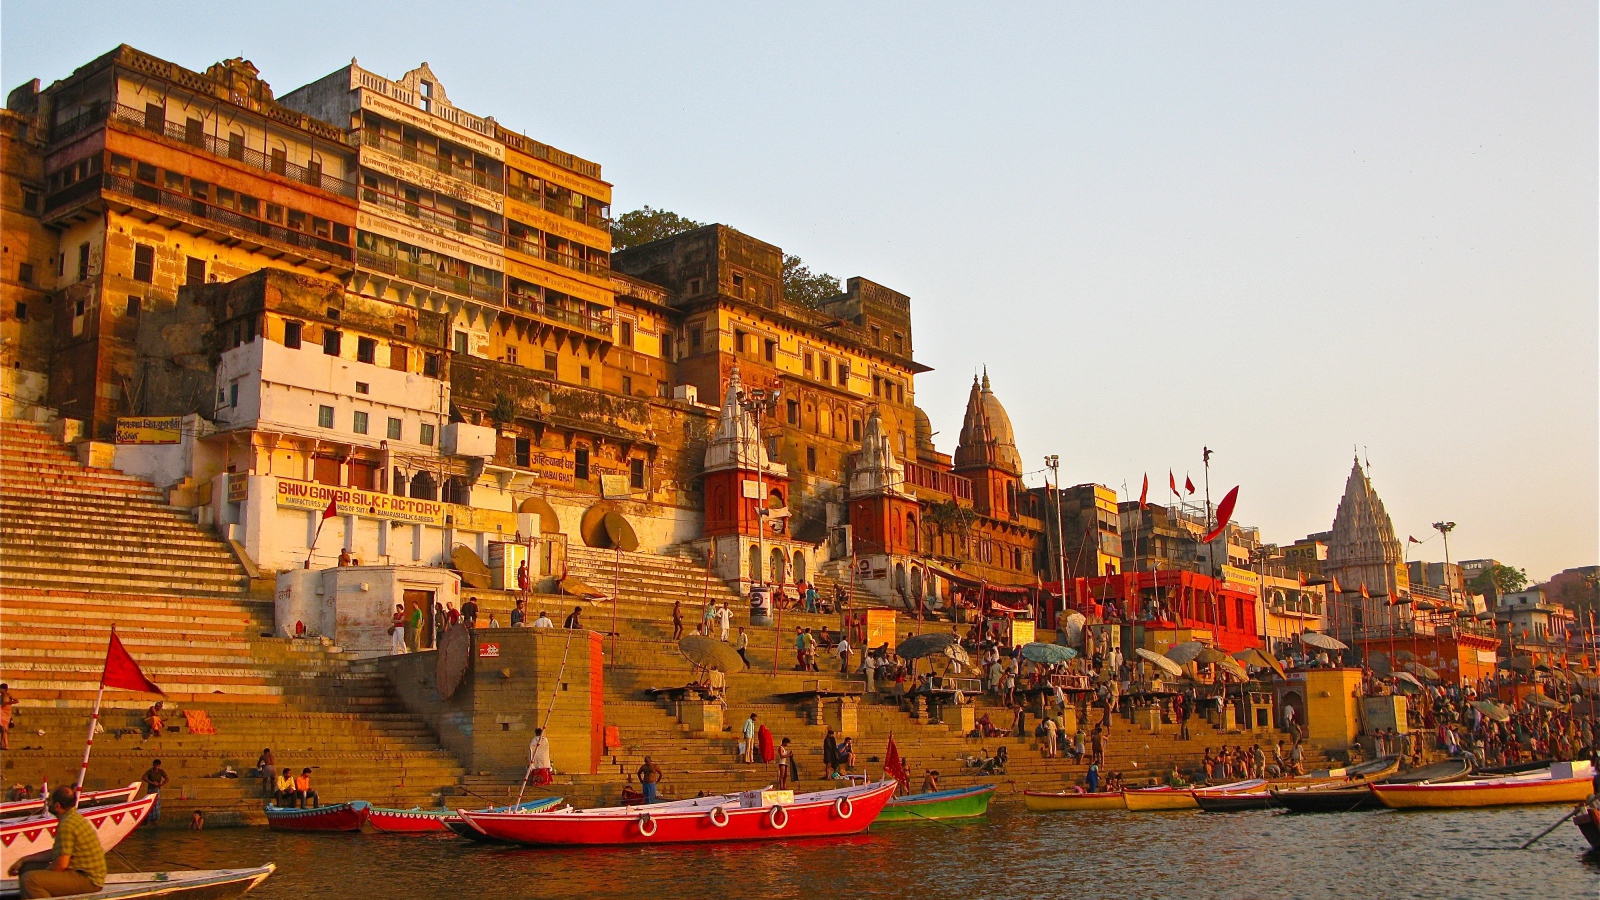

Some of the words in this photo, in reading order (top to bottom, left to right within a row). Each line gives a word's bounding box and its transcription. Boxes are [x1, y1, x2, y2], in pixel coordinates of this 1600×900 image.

[558, 473, 574, 484] GHAT
[278, 481, 308, 497] SHIV
[309, 486, 351, 504] GANGA
[352, 492, 381, 508] SILK
[381, 497, 441, 516] FACTORY
